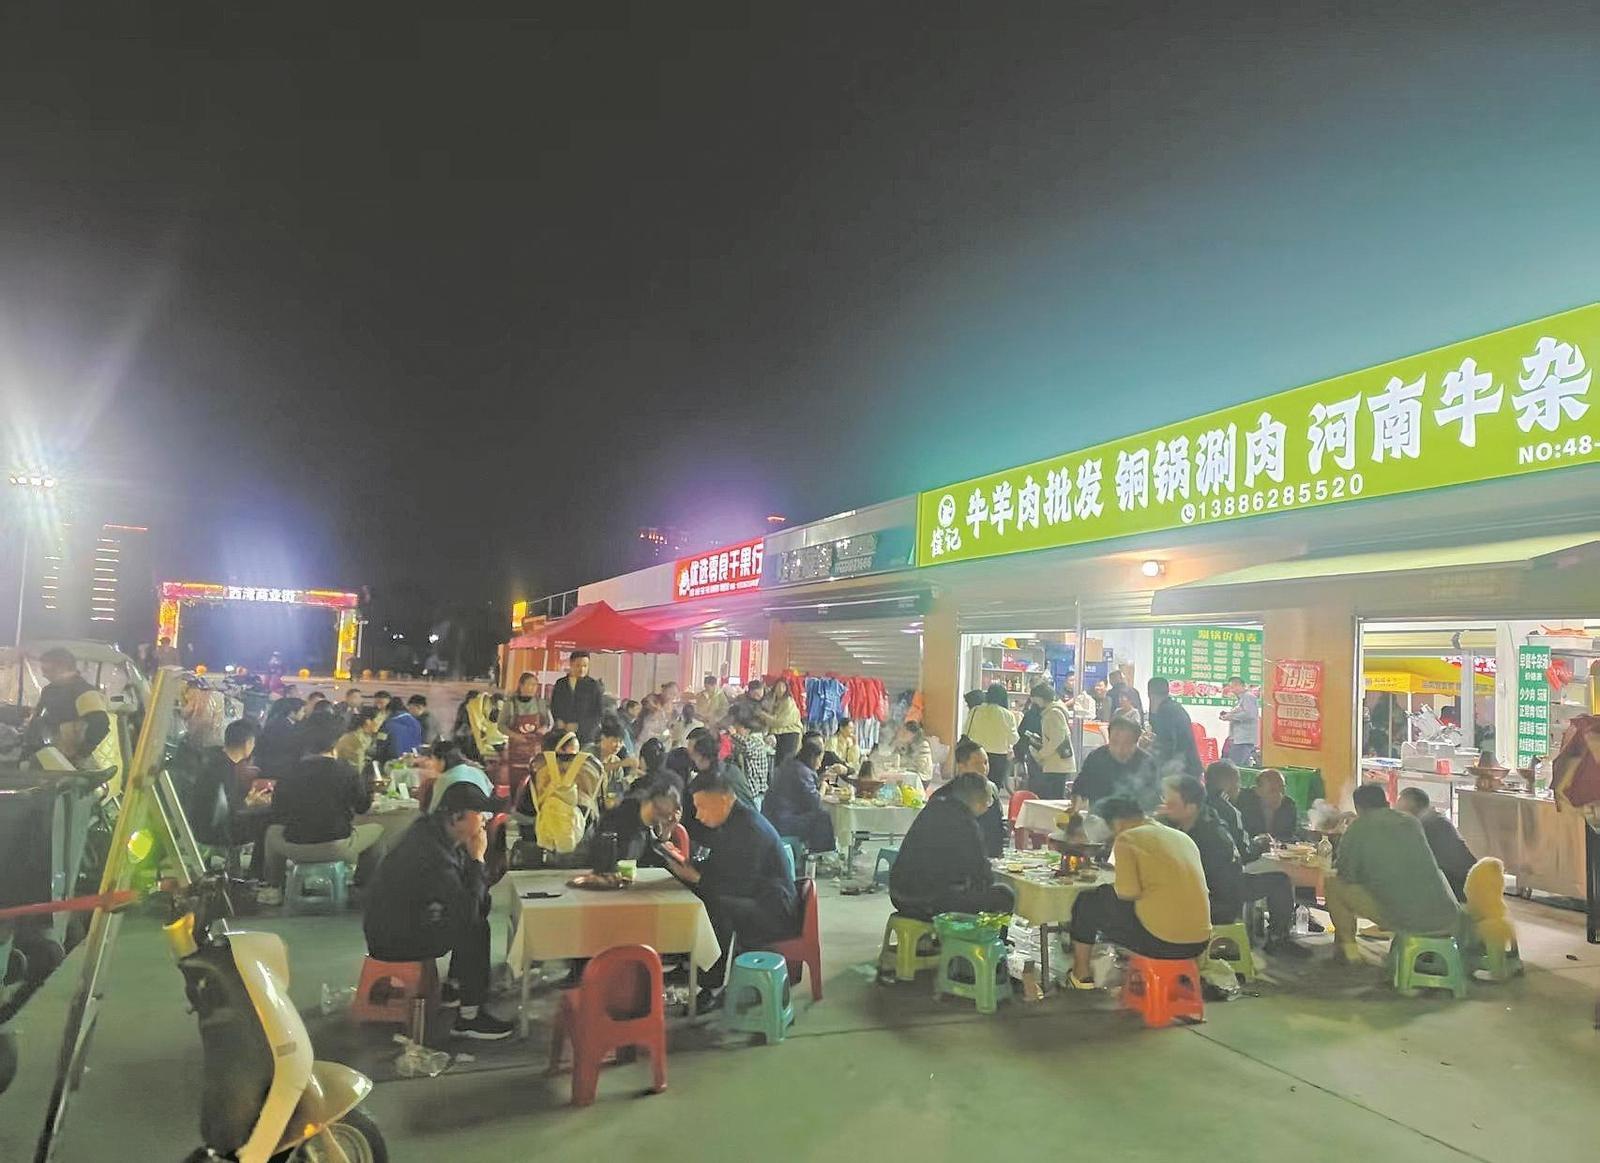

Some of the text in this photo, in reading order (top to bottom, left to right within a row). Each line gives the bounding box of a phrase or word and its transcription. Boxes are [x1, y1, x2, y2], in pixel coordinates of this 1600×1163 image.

[966, 336, 1593, 539] 牛羊肉批发 铜锅涮肉 河南牛杂
[1199, 473, 1364, 519] 13886285520
